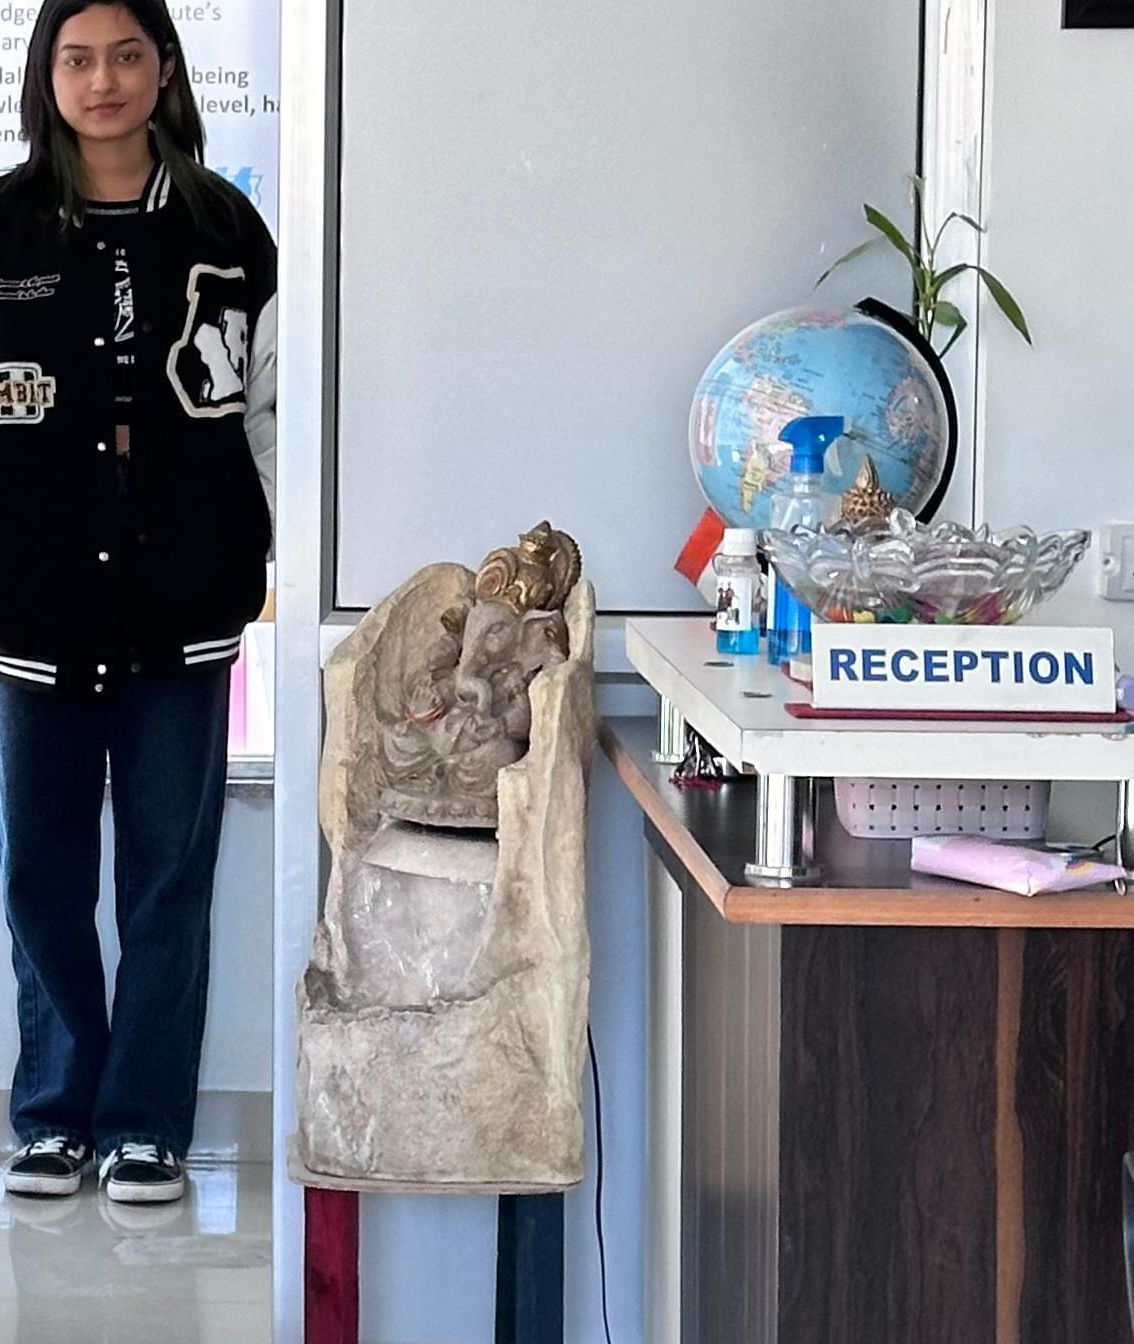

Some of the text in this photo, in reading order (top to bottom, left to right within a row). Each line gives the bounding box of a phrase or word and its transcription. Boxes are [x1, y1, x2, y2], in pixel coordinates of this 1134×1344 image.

[192, 66, 249, 89] being
[200, 95, 256, 117] level,
[829, 648, 1094, 685] RECEPTION
